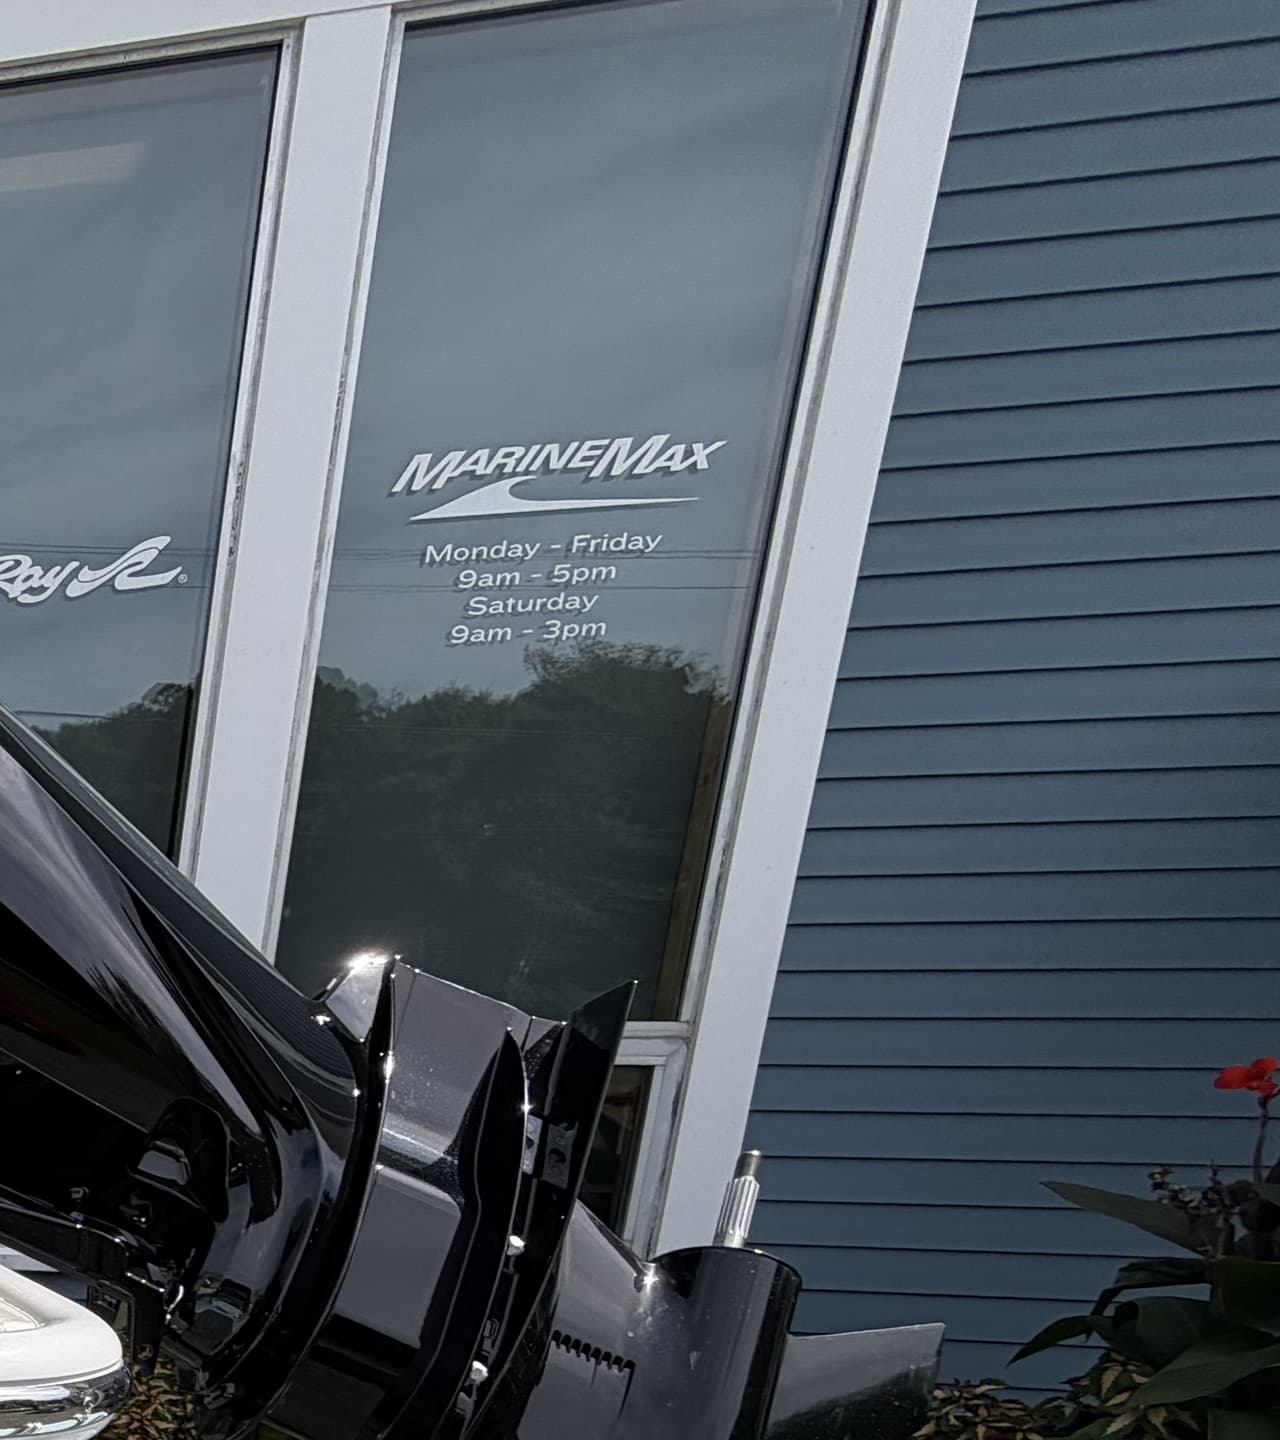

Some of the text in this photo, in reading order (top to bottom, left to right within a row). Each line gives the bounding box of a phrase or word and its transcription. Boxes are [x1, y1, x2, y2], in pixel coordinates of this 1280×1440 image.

[425, 539, 542, 564] Monday
[571, 531, 664, 554] Friday
[457, 569, 521, 589] 9am
[551, 563, 617, 585] 5pm
[466, 592, 600, 616] Saturday
[449, 624, 513, 644] 9am
[542, 619, 608, 640] 3pm
